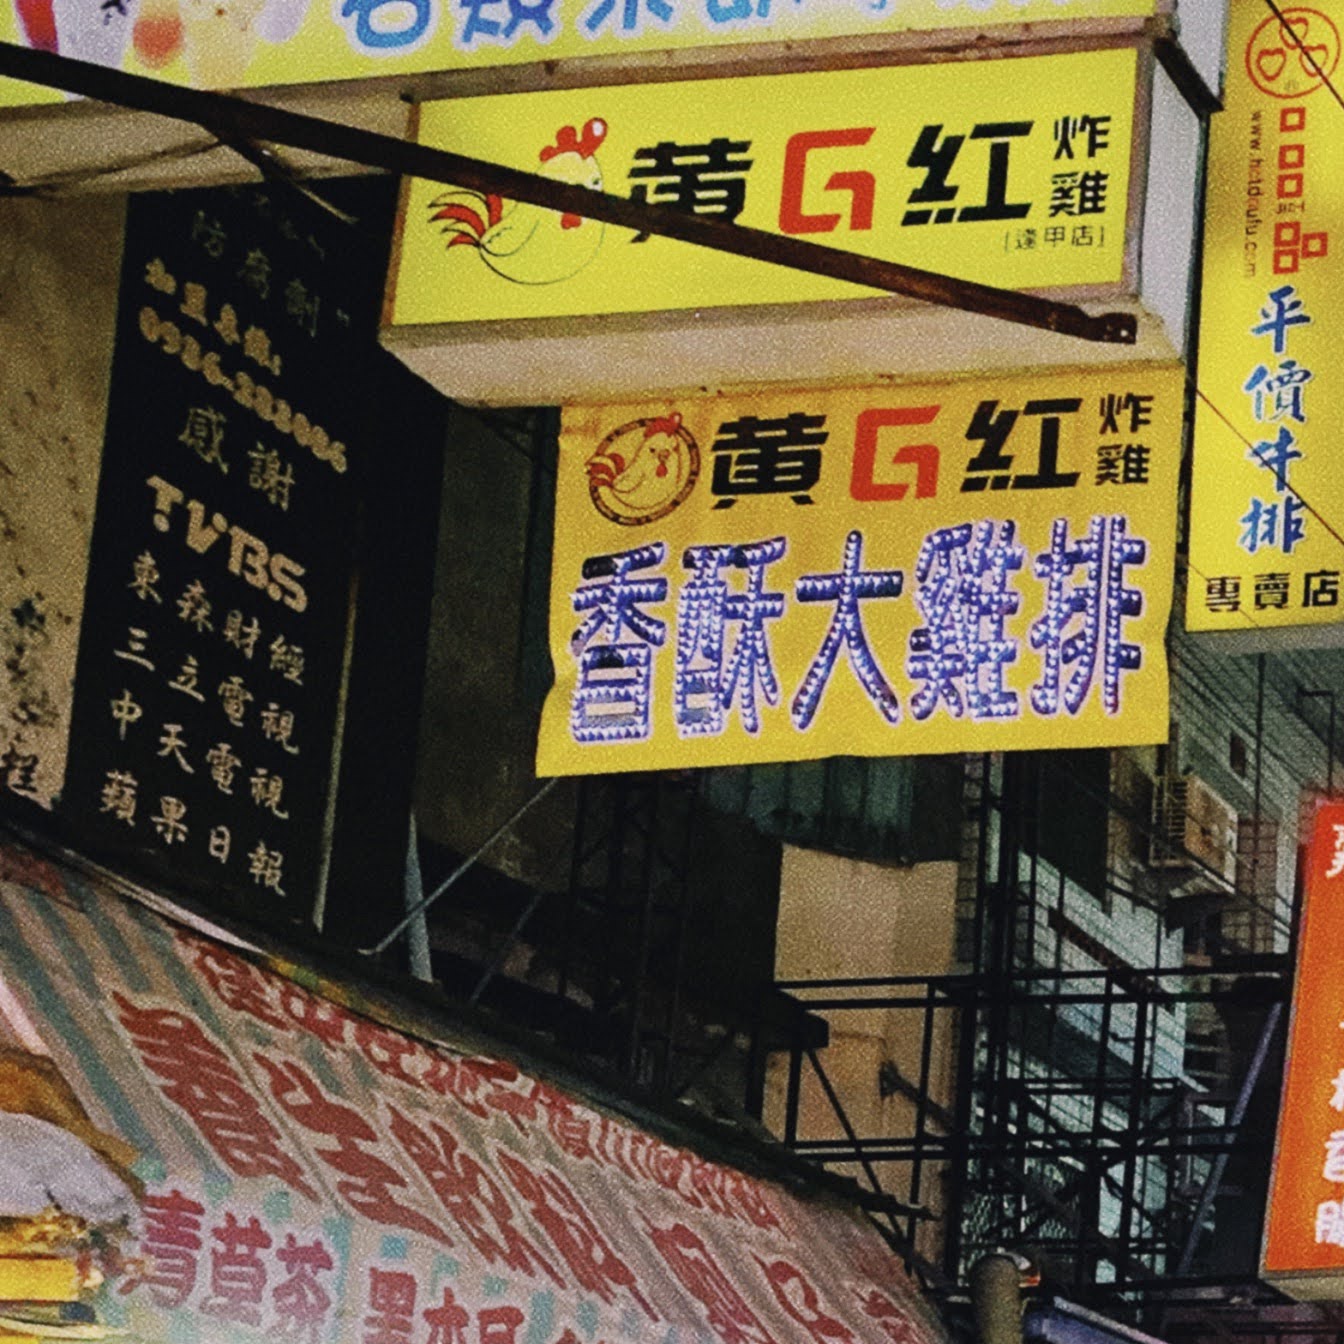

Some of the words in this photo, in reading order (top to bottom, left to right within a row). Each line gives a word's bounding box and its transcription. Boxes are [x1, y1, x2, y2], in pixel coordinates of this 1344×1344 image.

[1049, 114, 1111, 218] 炸雞
[178, 406, 295, 511] 感謝
[1095, 392, 1154, 486] 炸雞
[1240, 284, 1311, 555] 平價牛排
[146, 475, 309, 612] TVBS
[1205, 570, 1340, 613] 專賣店
[127, 551, 305, 686] 東森財經
[570, 514, 1150, 745] 香酥大雞排
[110, 690, 289, 820] 中天電視
[114, 627, 300, 755] 三立電視
[100, 769, 287, 897] 蘋果日報
